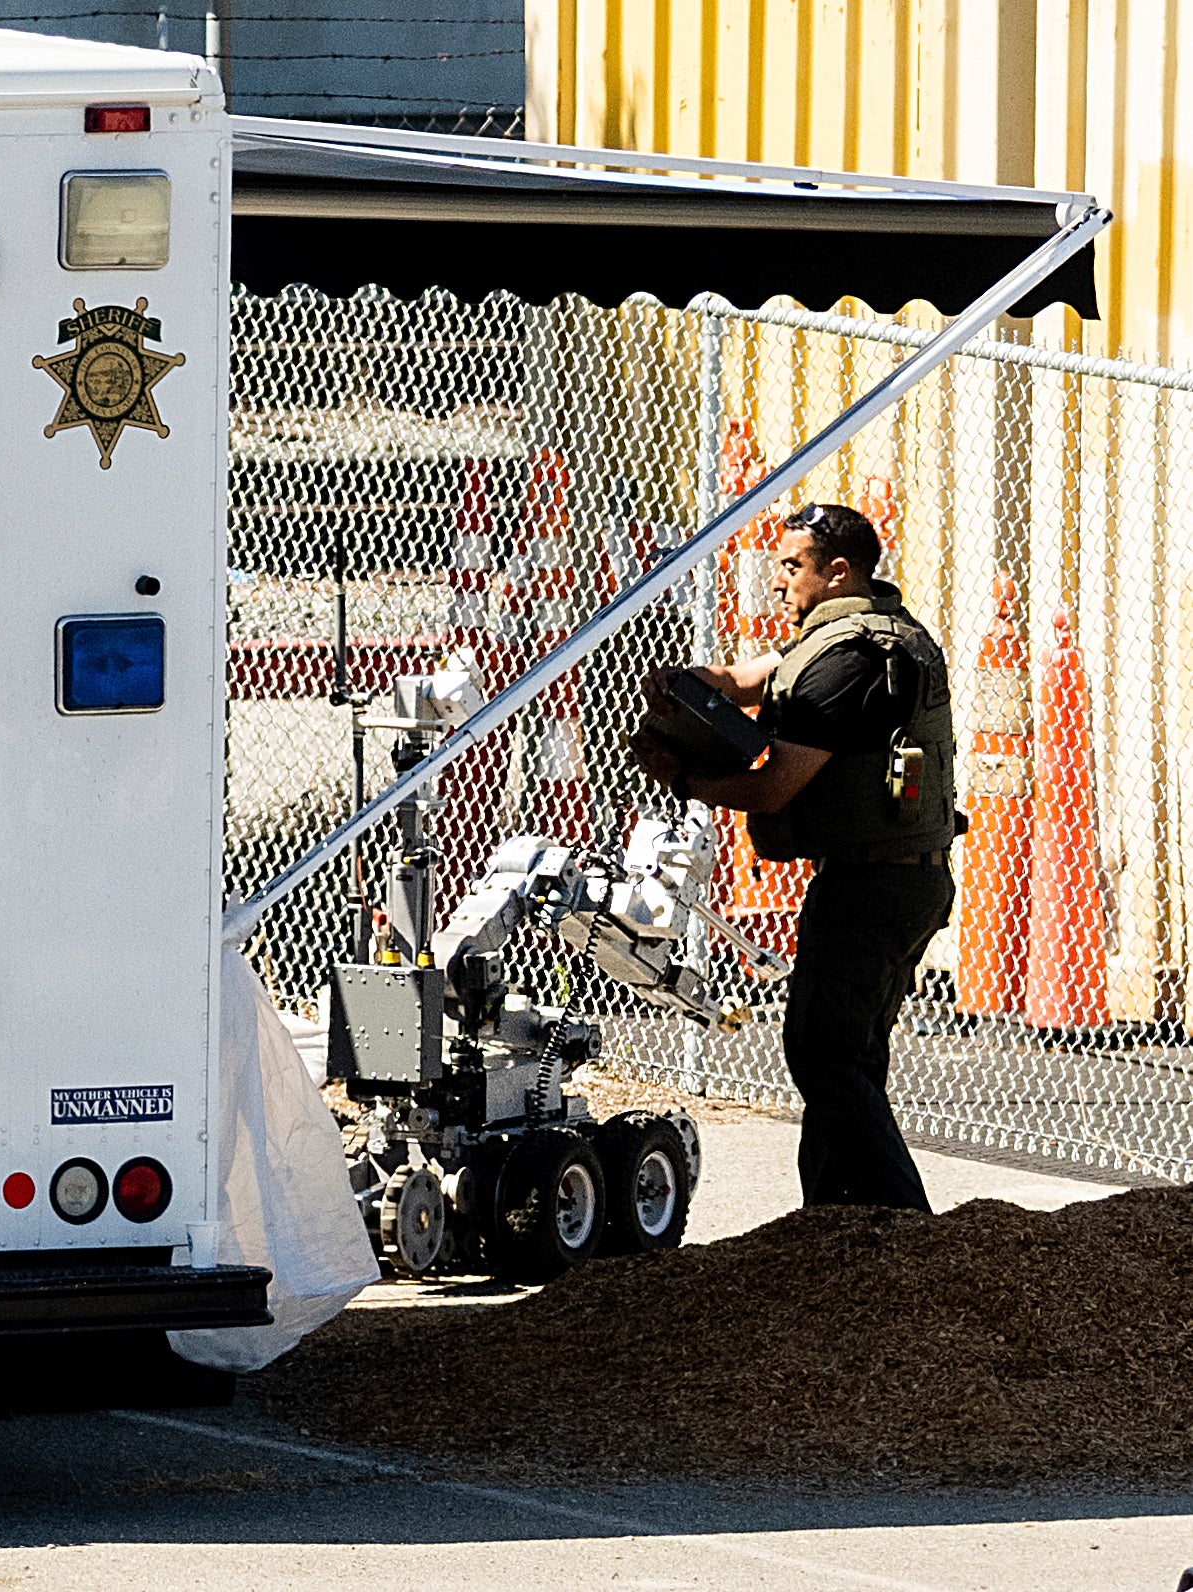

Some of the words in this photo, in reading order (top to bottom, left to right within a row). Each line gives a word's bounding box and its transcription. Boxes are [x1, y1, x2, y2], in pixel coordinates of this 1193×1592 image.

[66, 308, 152, 337] SHERIFF
[54, 1091, 72, 1101] MY
[73, 1090, 111, 1100] OTHER
[114, 1089, 159, 1098] VEHICLE
[161, 1087, 172, 1097] IS
[53, 1098, 172, 1118] UNMANNED
